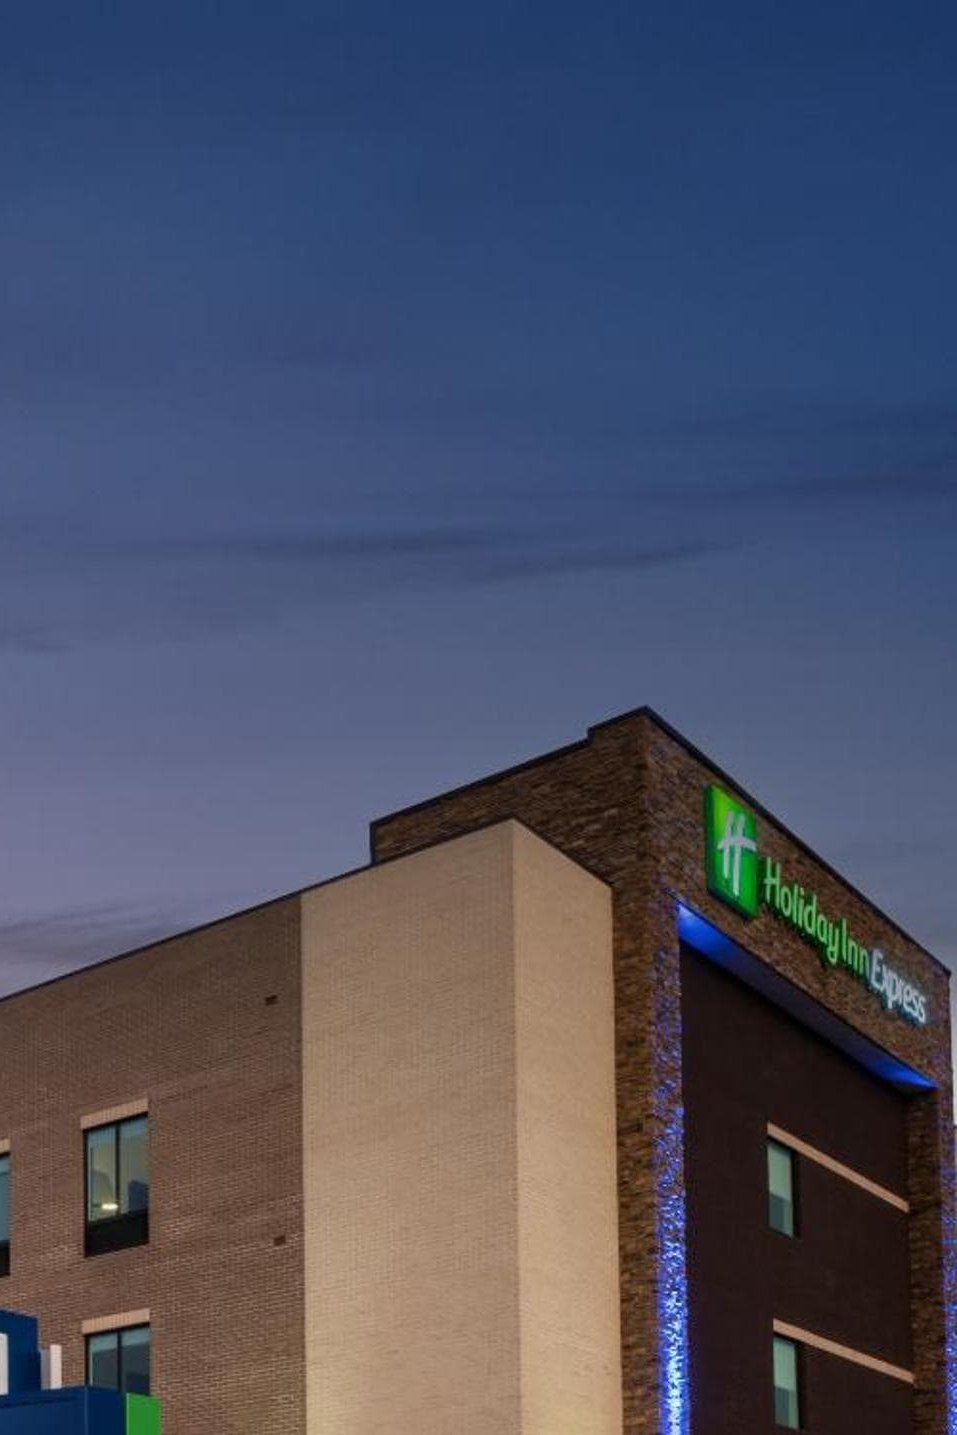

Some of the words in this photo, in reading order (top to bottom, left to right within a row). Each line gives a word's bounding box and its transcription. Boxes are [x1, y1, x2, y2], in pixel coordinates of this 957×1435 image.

[763, 857, 839, 964] Holiday
[841, 918, 870, 975] Inn
[870, 948, 927, 1025] Express
